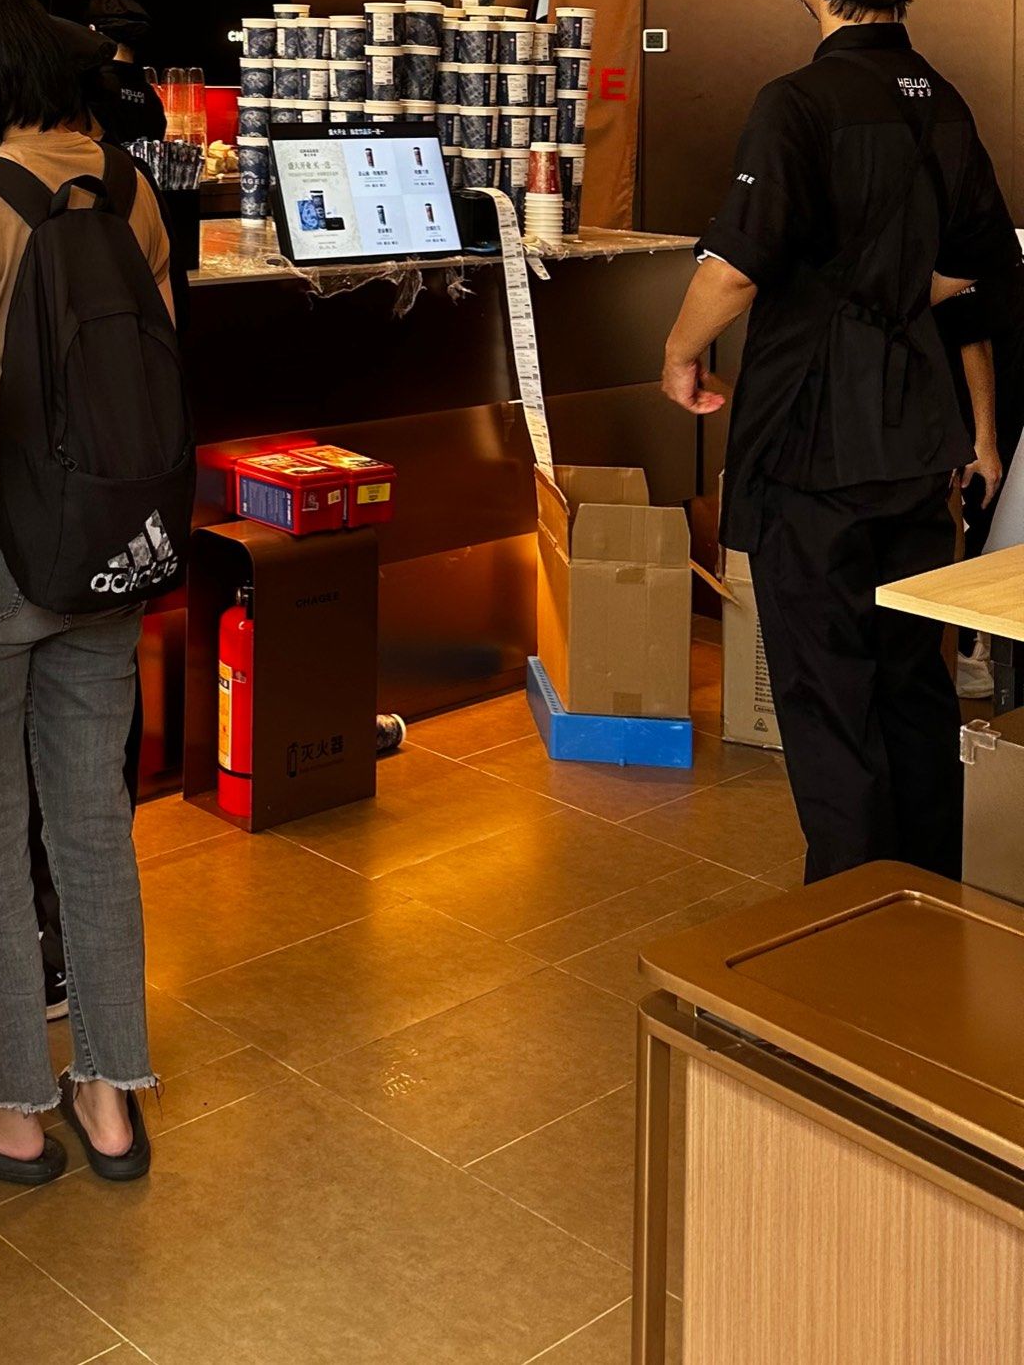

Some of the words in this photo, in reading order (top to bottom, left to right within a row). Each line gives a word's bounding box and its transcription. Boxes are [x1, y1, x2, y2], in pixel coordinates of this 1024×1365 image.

[897, 77, 931, 89] HELLO!
[301, 735, 345, 763] 灭火器
